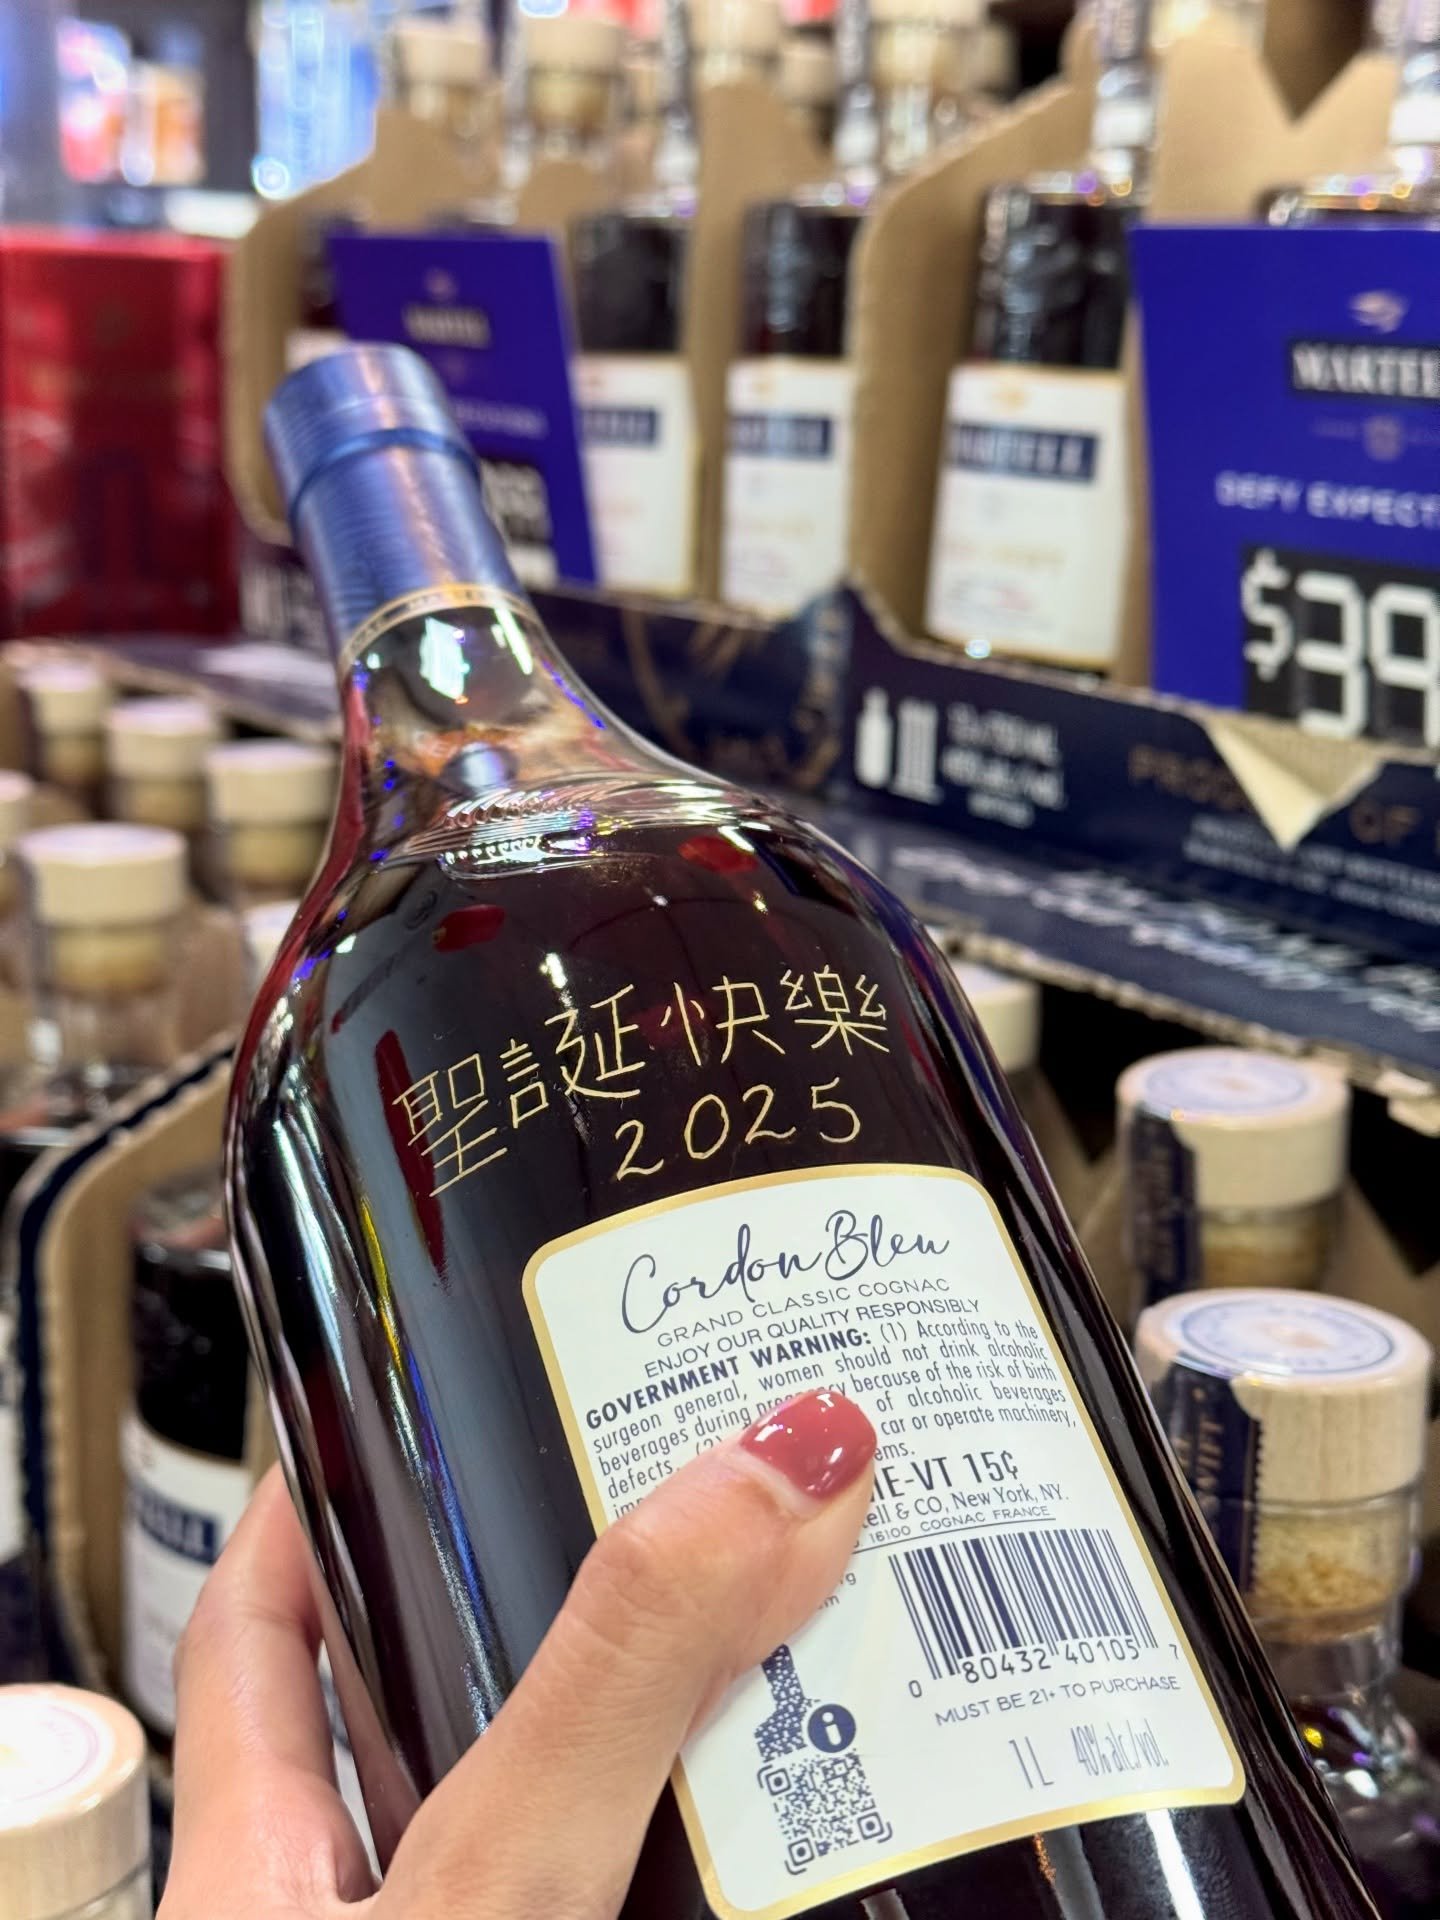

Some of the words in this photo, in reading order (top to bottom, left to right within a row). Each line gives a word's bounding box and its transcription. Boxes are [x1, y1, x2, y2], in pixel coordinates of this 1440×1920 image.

[614, 1076, 862, 1181] 2025
[621, 1223, 822, 1334] Cordon
[657, 1310, 743, 1348] GRAND
[752, 1287, 850, 1318] CLASSIC
[858, 1278, 950, 1298] COGNAC
[586, 1355, 740, 1430] GOVERNMENT
[749, 1328, 872, 1368] WARNING:
[880, 1321, 907, 1344] (1)
[916, 1316, 991, 1340] According
[994, 1320, 1011, 1336] to
[1015, 1319, 1039, 1339] the
[644, 1342, 710, 1379] ENJOY
[717, 1328, 762, 1353] OUR
[767, 1308, 849, 1338] QUALITY
[856, 1299, 980, 1321] RESPONSIBLY
[593, 1412, 663, 1454] surgeon
[673, 1379, 748, 1424] general,
[758, 1362, 824, 1392] women
[835, 1345, 892, 1373] should
[902, 1343, 929, 1362] not
[939, 1339, 980, 1359] drink
[988, 1337, 1048, 1360] alcoholic
[598, 1427, 690, 1477] beverages
[694, 1406, 752, 1438] during
[850, 1370, 921, 1394] because
[925, 1360, 942, 1382] of
[945, 1359, 972, 1379] the
[976, 1358, 1004, 1378] risk
[1007, 1359, 1022, 1378] of
[1022, 1359, 1057, 1382] birth
[880, 1418, 906, 1436] car
[911, 1414, 928, 1430] or
[933, 1405, 995, 1430] operate
[998, 1402, 1077, 1428] machinery,
[607, 1458, 681, 1500] defects.
[876, 1390, 894, 1413] of
[907, 1381, 983, 1408] alcoholic
[989, 1380, 1067, 1406] beverages
[962, 1449, 1019, 1483] 15¢
[869, 1524, 911, 1544] 16100
[920, 1511, 986, 1532] COGNAC
[992, 1505, 1050, 1520] FRANCE
[895, 1502, 910, 1520] &
[914, 1495, 949, 1517] CO,
[949, 1490, 991, 1511] New
[993, 1483, 1038, 1505] York,
[1039, 1483, 1070, 1501] NY.
[907, 1679, 923, 1698] 0
[961, 1648, 1052, 1684] 80432
[1065, 1638, 1140, 1665] 40105
[1167, 1643, 1180, 1660] 7
[934, 1699, 991, 1727] MUST
[997, 1692, 1027, 1713] BE
[1029, 1688, 1056, 1706] 21+
[1059, 1683, 1087, 1699] TO
[1091, 1675, 1181, 1697] PURCHASE
